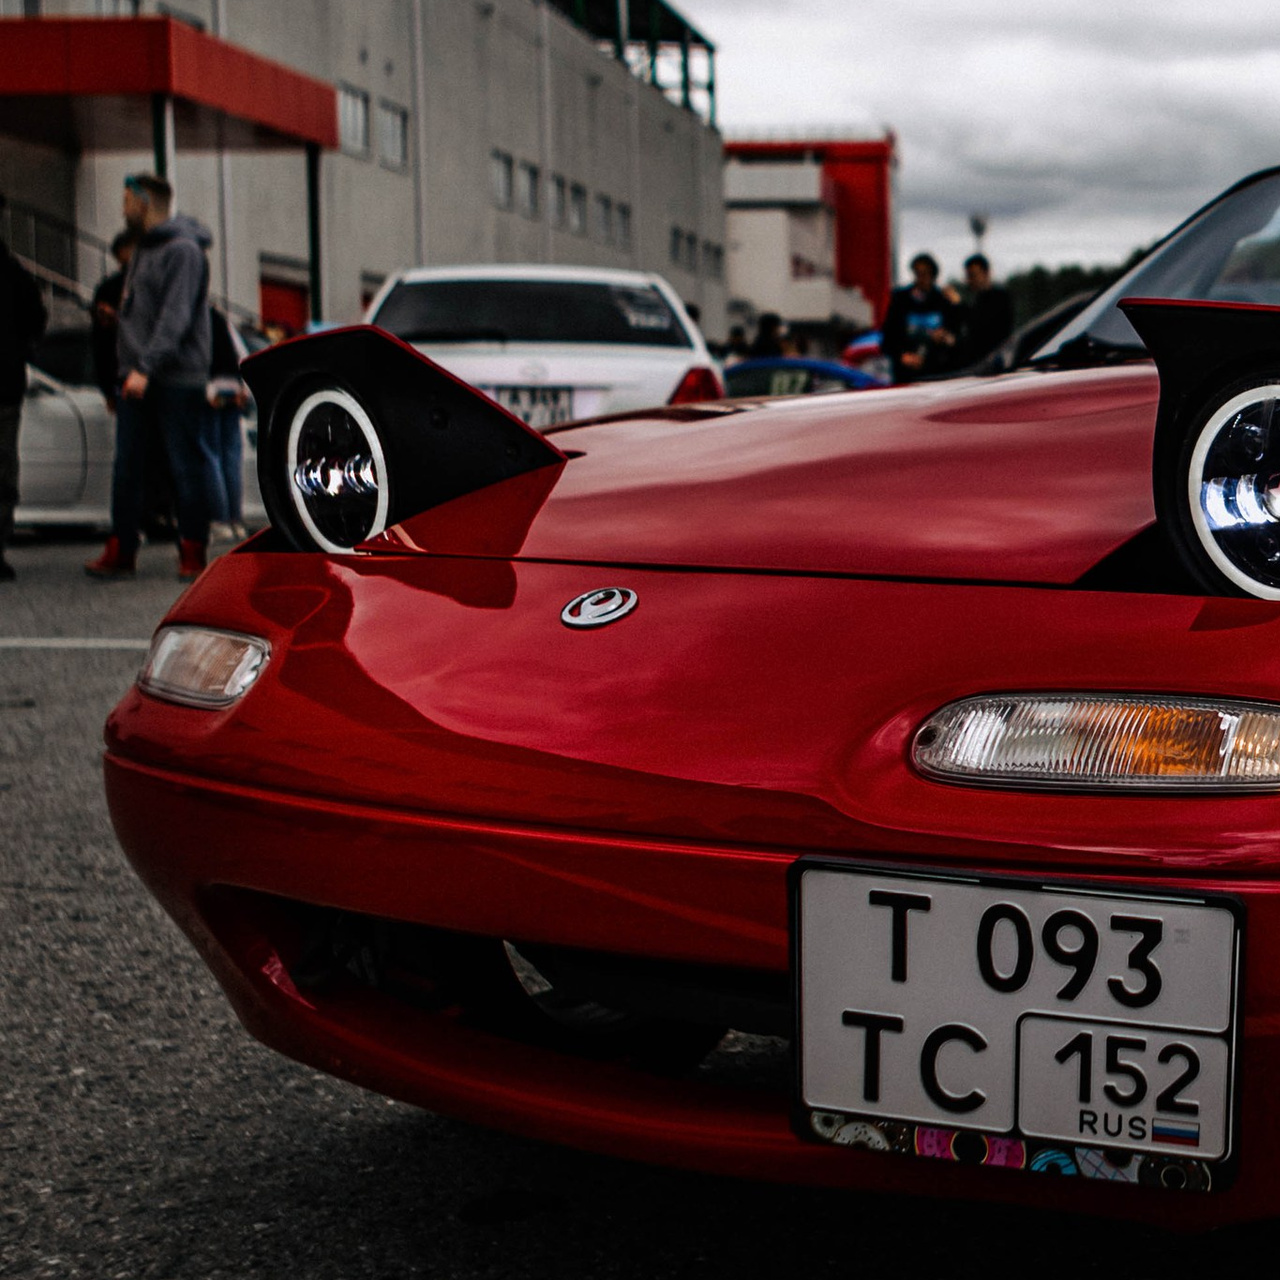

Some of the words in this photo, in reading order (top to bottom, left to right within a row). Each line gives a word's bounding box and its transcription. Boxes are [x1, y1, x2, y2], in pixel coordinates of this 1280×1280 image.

[869, 889, 931, 983] T
[976, 902, 1163, 1008] 093
[841, 1009, 988, 1113] TC
[1054, 1031, 1201, 1116] 152
[1078, 1109, 1147, 1140] RUS
